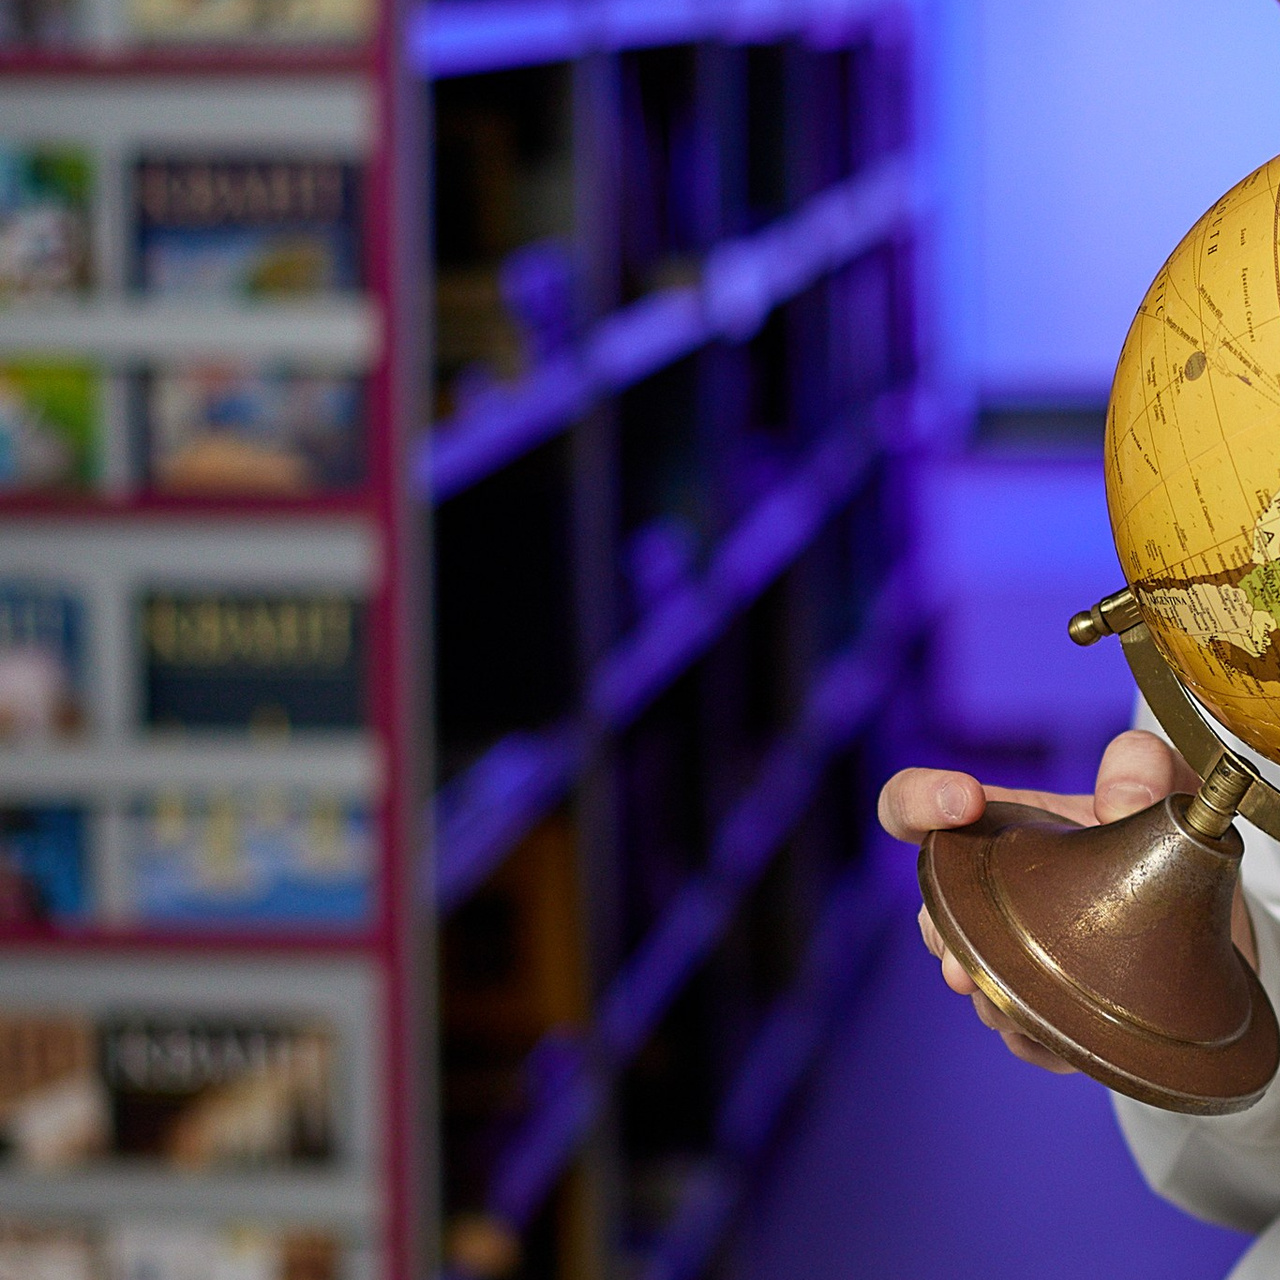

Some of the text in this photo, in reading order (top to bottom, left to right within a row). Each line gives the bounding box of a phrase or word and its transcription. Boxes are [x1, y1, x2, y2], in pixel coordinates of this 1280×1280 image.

[1242, 268, 1250, 307] Equatorial
[1246, 311, 1255, 342] Current
[1144, 454, 1158, 475] Current
[1255, 490, 1266, 510] Lima
